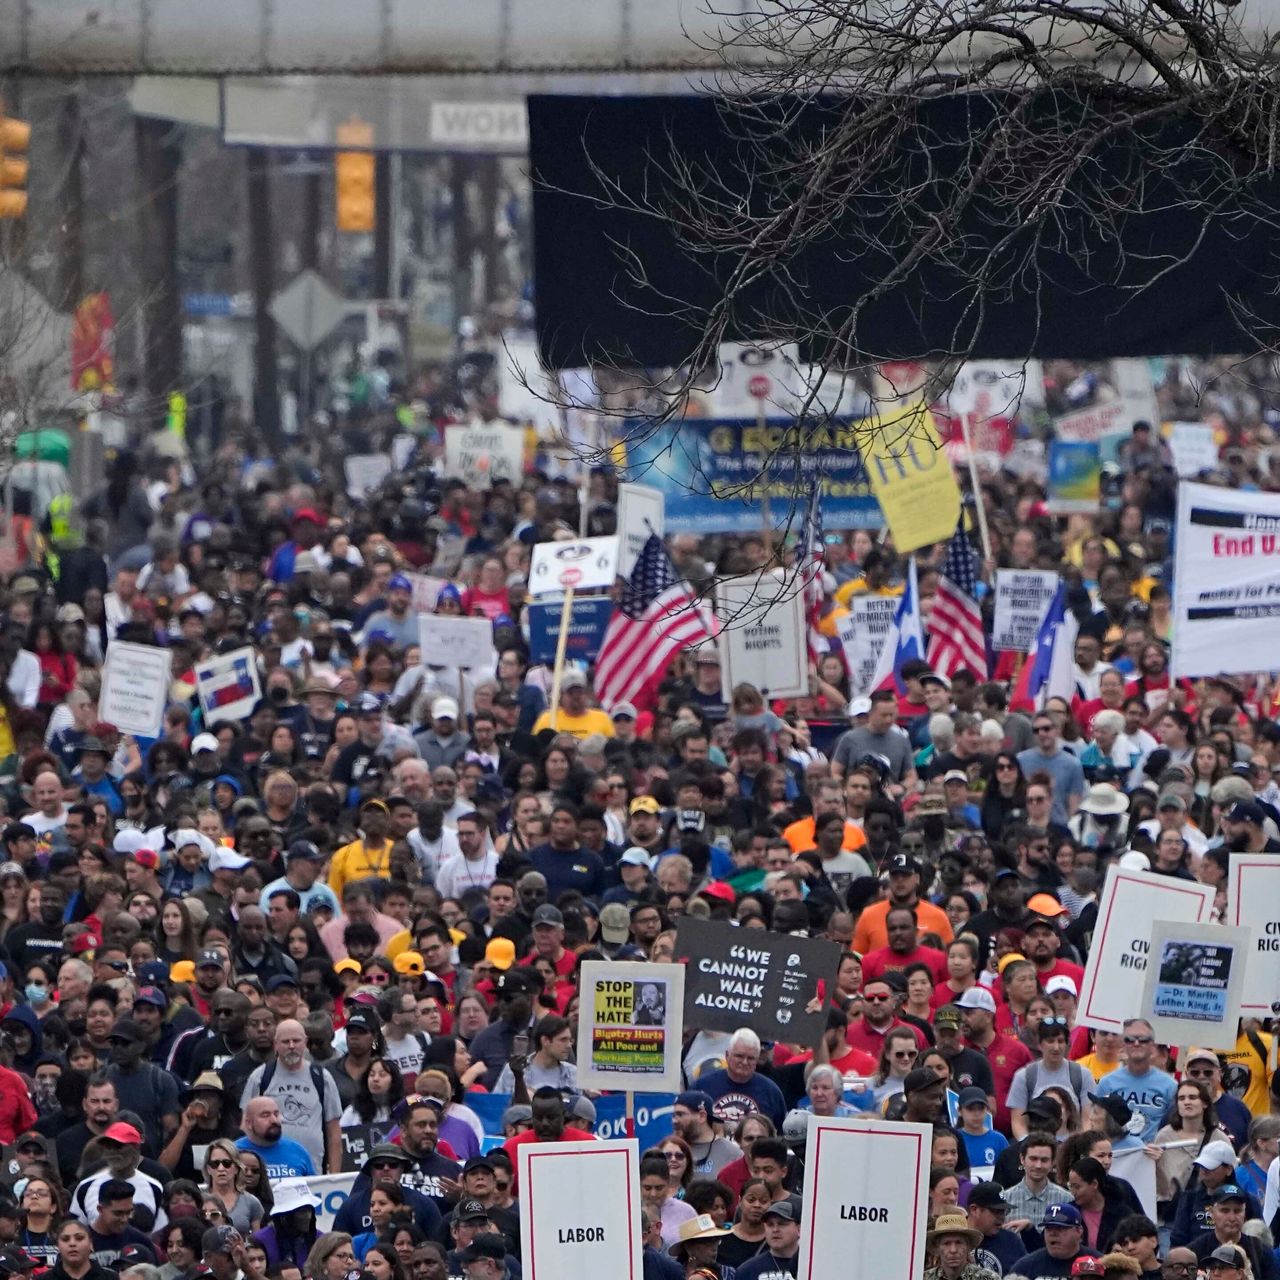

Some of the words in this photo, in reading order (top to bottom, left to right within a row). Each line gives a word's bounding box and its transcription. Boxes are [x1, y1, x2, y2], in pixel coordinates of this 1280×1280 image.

[1211, 532, 1255, 559] End
[1131, 940, 1150, 954] CIV
[730, 945, 770, 965] “WE
[698, 959, 768, 981] CANNOT
[595, 981, 632, 993] STOP
[720, 979, 764, 997] WALK
[606, 996, 631, 1008] THE
[1188, 990, 1218, 1000] Martin
[695, 993, 761, 1014] ALONE.”
[1156, 997, 1186, 1008] Luther
[1188, 999, 1211, 1010] King,
[1213, 1001, 1224, 1010] Jr.
[596, 1012, 631, 1024] HATE
[595, 1030, 630, 1041] Bigotry
[633, 1030, 663, 1040] Hurts
[600, 1042, 617, 1051] All
[619, 1042, 640, 1051] Poor
[641, 1043, 657, 1051] and
[840, 1205, 889, 1223] LABOR
[558, 1226, 606, 1244] LABOR
